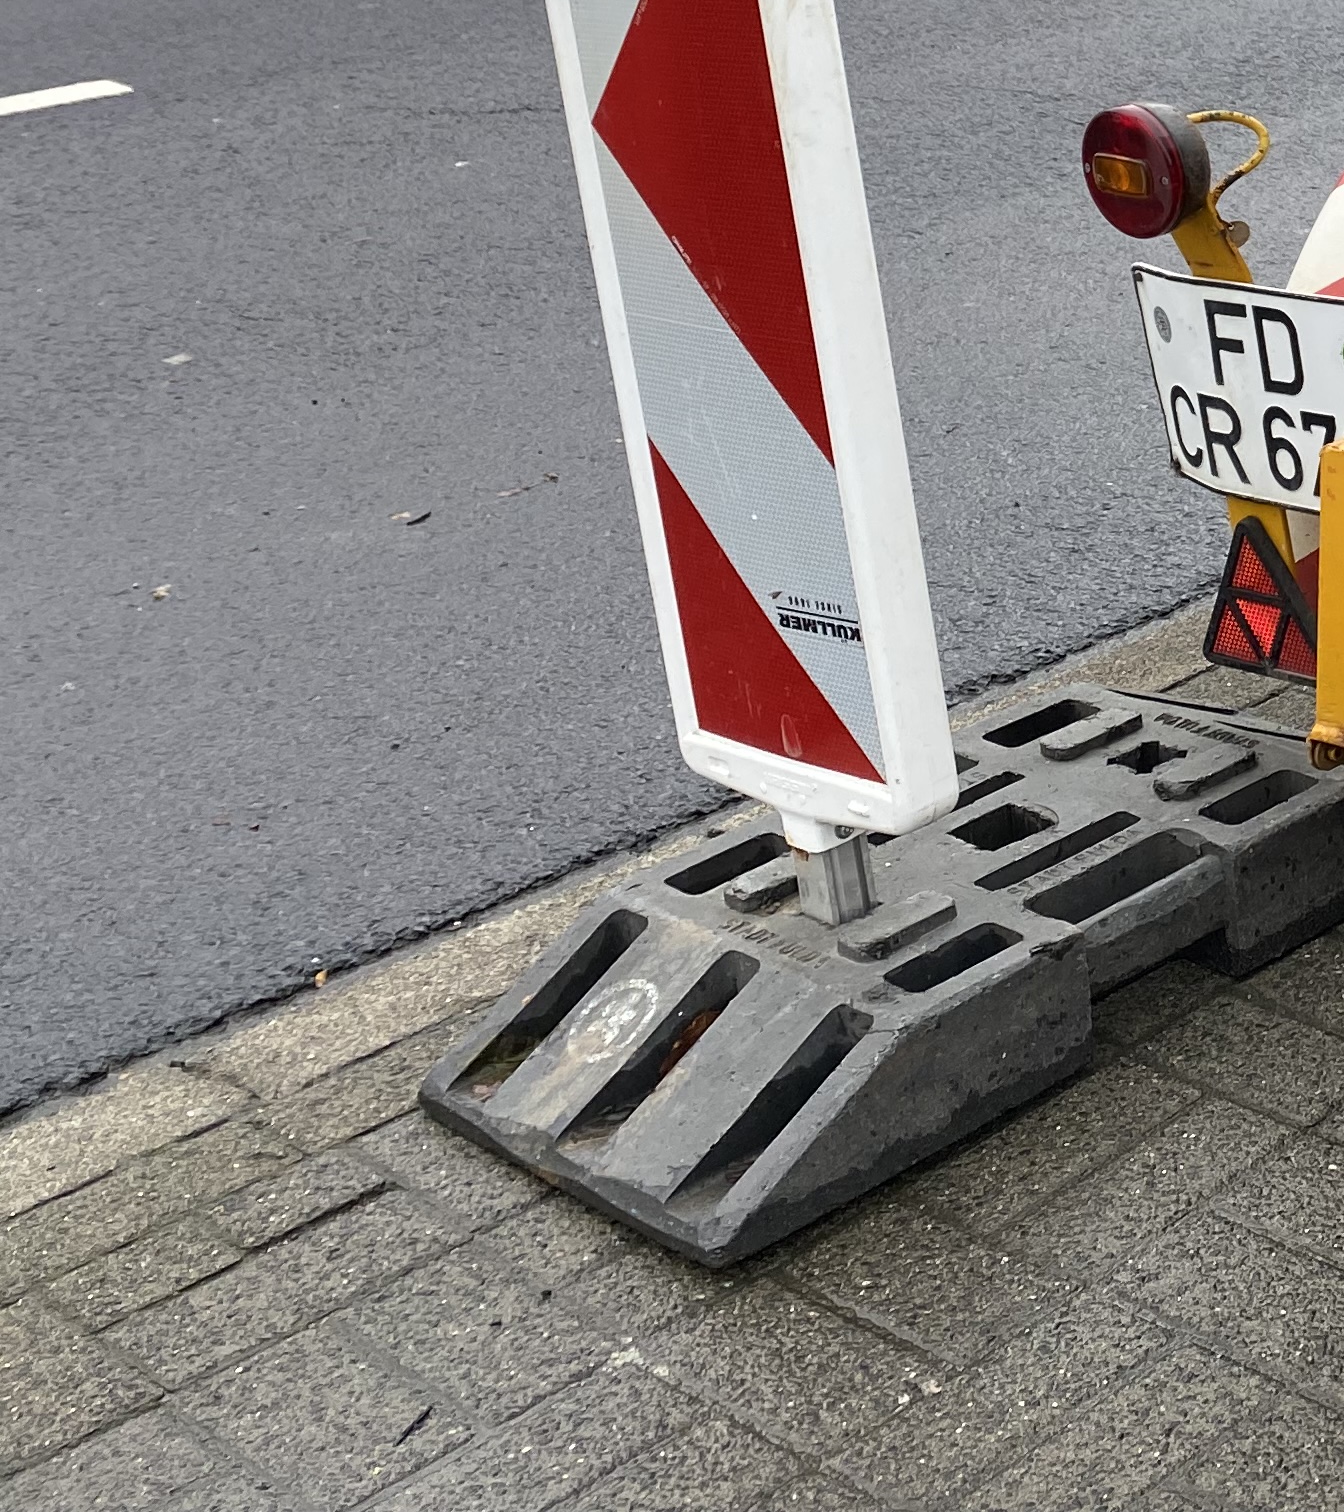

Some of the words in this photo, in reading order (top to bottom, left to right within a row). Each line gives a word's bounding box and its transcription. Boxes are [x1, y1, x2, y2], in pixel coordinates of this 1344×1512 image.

[1203, 299, 1304, 396] FD
[1170, 384, 1252, 486] CR
[778, 612, 861, 643] KÜLLMER
